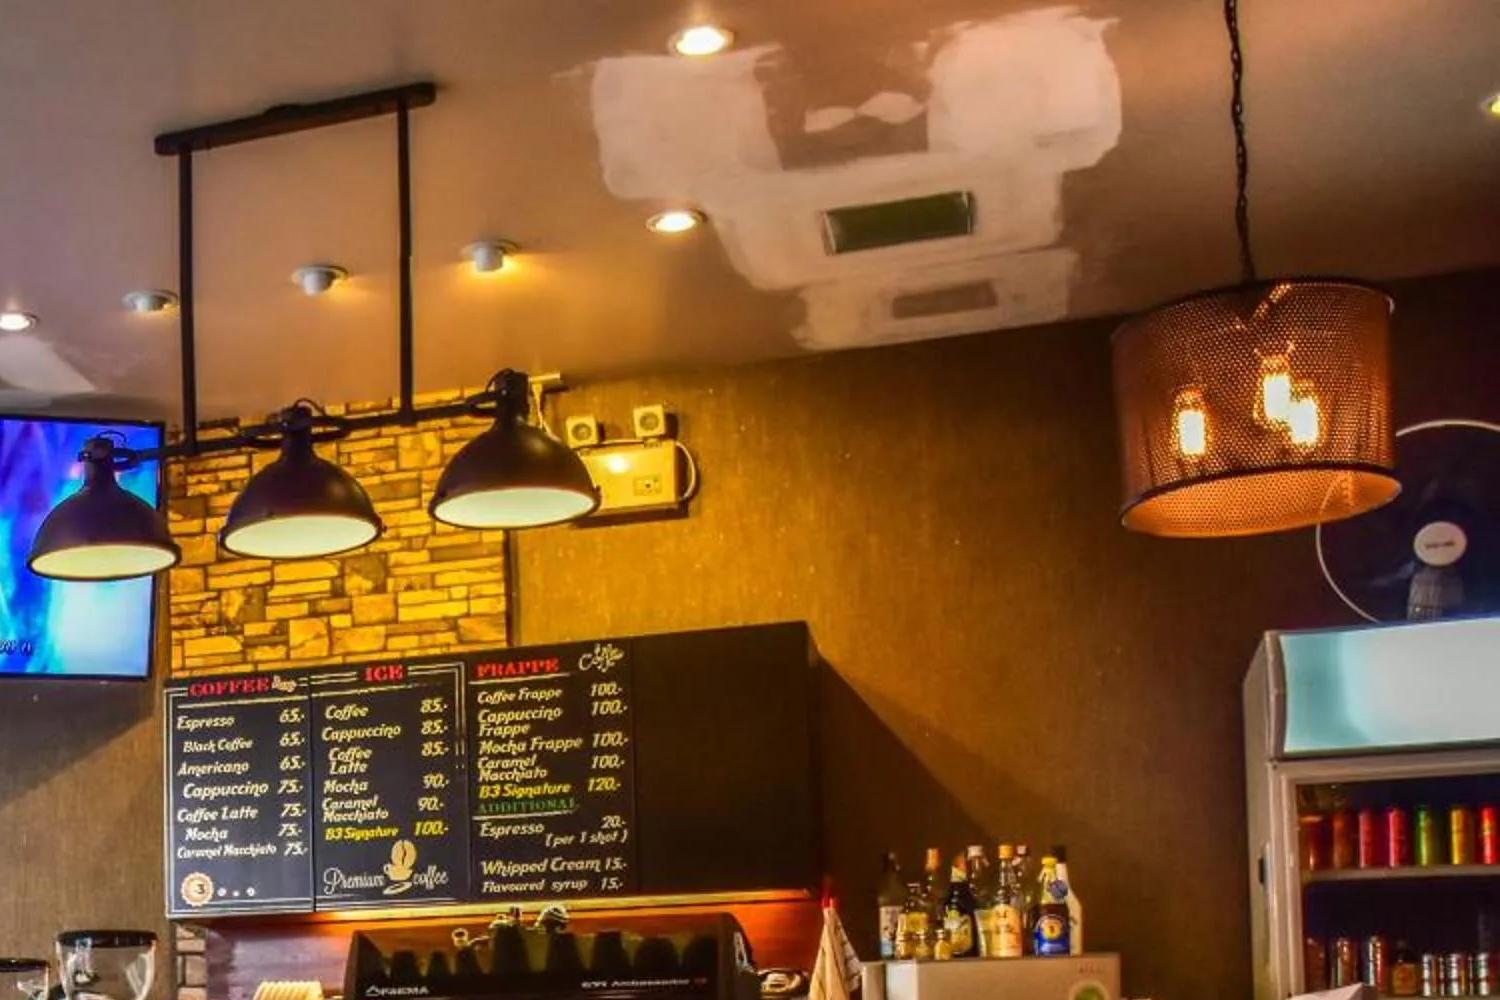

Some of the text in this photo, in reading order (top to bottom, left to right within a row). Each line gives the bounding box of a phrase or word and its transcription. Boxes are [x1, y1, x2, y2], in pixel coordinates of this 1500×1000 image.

[364, 664, 404, 682] ICE
[477, 658, 559, 678] FRAPPE
[189, 677, 270, 697] COFFEE
[477, 691, 516, 705] Coffee
[518, 687, 563, 703] Frappe
[325, 703, 369, 720] Coffee
[478, 708, 562, 725] Cappuccino
[177, 715, 235, 731] Espresso
[478, 722, 530, 738] Frappe
[321, 724, 401, 743] Cappuccino
[183, 740, 215, 753] Black
[218, 738, 253, 751] Coffee
[479, 739, 526, 756] Mocha
[530, 736, 583, 752] Frappe
[329, 747, 372, 762] Coffee
[477, 755, 536, 770] Caramel
[177, 762, 249, 776] Americano
[329, 760, 367, 775] Latte
[478, 767, 548, 782] Macchiato
[183, 782, 269, 801] Cappuccino
[324, 779, 368, 795] Mocha
[503, 782, 572, 799] Signature
[322, 796, 379, 810] Caramel
[177, 808, 218, 826] Coffee
[221, 806, 258, 820] Latte
[323, 809, 388, 824] Macchiato
[185, 826, 228, 842] Mocha
[479, 822, 545, 838] Espresso
[481, 861, 546, 878] Whipped
[550, 857, 600, 873] Cream
[481, 880, 545, 894] Flavoured
[551, 880, 588, 894] syrup
